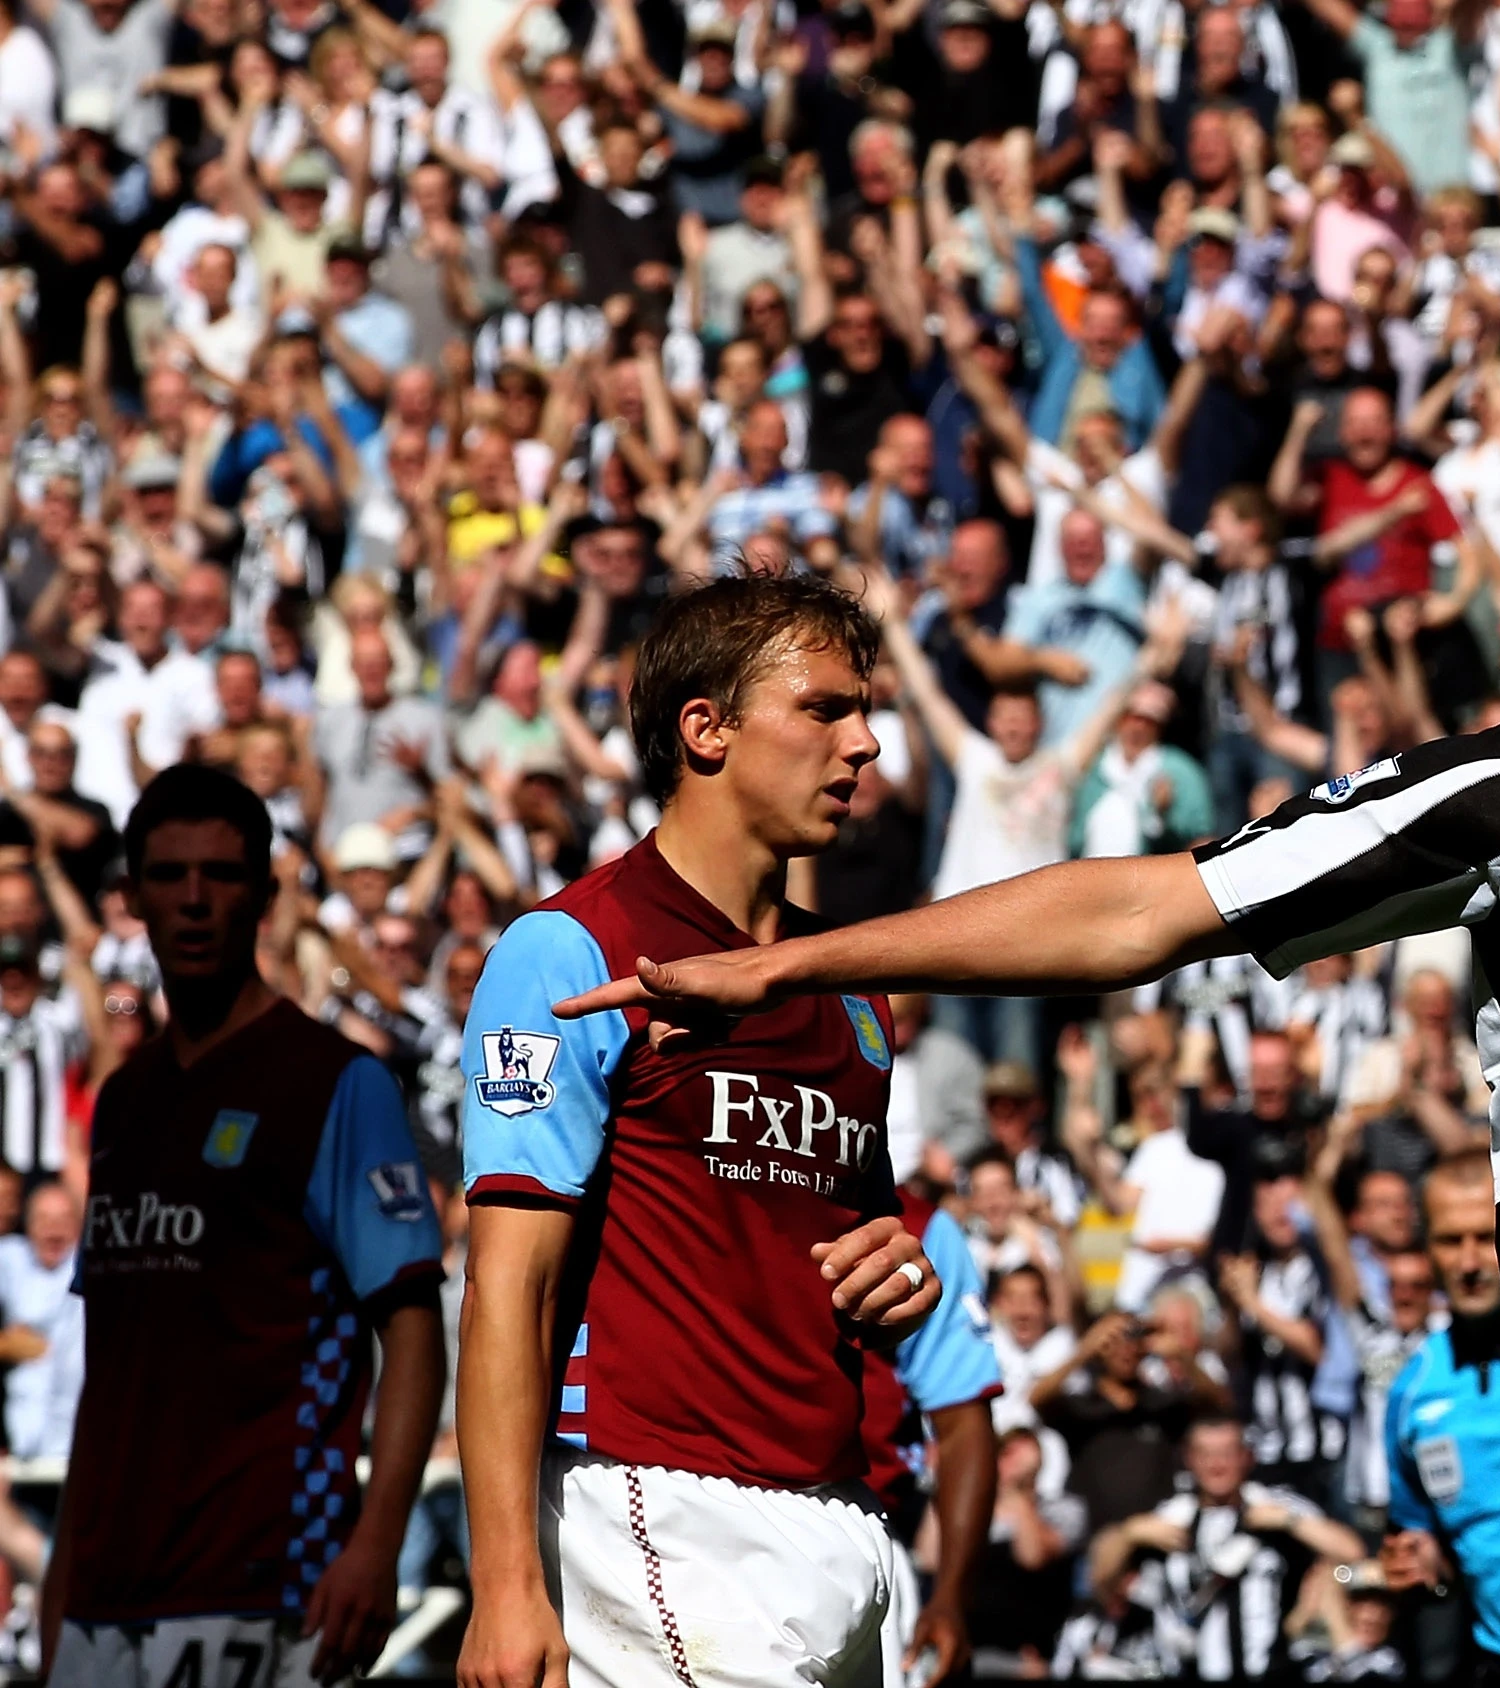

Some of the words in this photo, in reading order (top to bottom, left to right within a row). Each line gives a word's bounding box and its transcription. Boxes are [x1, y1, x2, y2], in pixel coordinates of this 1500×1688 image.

[486, 1082, 531, 1093] BARCLAYS
[702, 1071, 878, 1173] FxPro
[704, 1155, 762, 1181] Trade
[85, 1192, 205, 1247] FxPro
